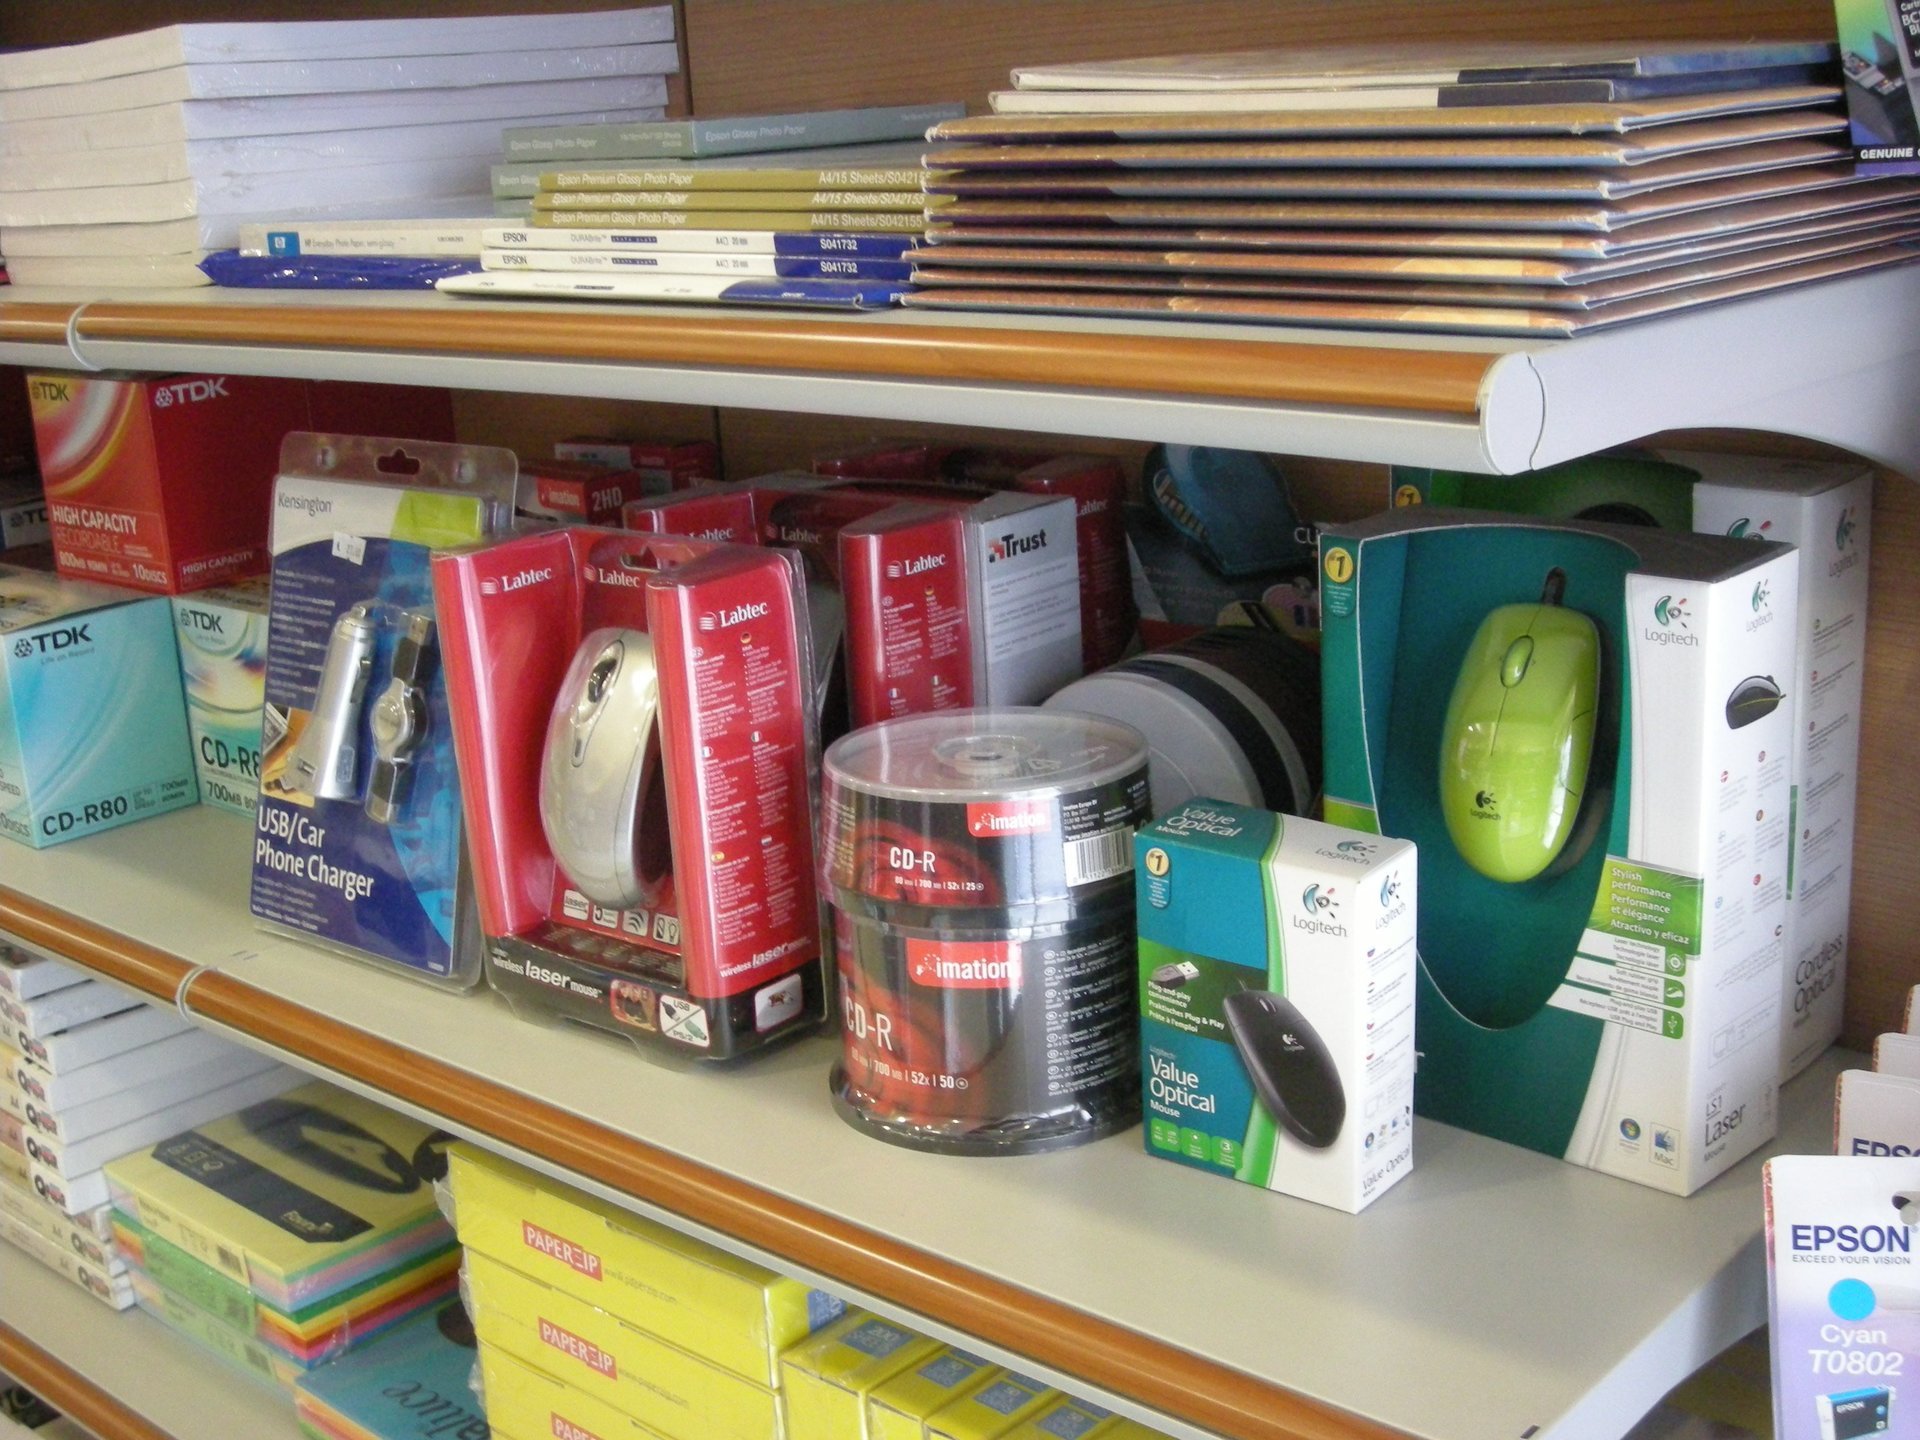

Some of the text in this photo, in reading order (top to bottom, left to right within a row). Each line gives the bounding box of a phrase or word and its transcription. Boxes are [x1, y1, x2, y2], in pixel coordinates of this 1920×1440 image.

[554, 138, 575, 149] Photo
[576, 138, 598, 150] Paper
[705, 125, 807, 143] Epson Glossy Photo Paper
[1860, 147, 1914, 160] GENUINE
[557, 172, 694, 187] Epson Premium Glossy Photo Paper
[819, 171, 847, 184] A4/15
[552, 192, 688, 206] Epson Premium Glossy Photo Paper
[811, 193, 925, 206] A4/15 Sheets/S042155
[552, 212, 688, 226] Epson Premium Glossy Photo Paper
[811, 213, 923, 228] A4/15 Sheets/S042155
[502, 232, 528, 243] EPSON
[819, 238, 858, 251] S041732
[502, 254, 528, 265] EPSON
[820, 261, 858, 274] S041732
[39, 382, 70, 402] TDK
[170, 377, 230, 405] TDK
[278, 492, 333, 518] Kensington
[592, 486, 623, 512] 2HD
[52, 504, 137, 535] HIGH CAPACITY
[781, 525, 823, 545] Labtec
[1002, 528, 1048, 559] Trust
[182, 562, 207, 576] HIGH
[207, 550, 254, 570] CAPACITY
[905, 553, 946, 577] Labtec
[501, 567, 553, 593] Labtec
[598, 568, 641, 589] Labtec
[189, 609, 225, 635] TDK
[719, 602, 769, 629] Labtec
[31, 623, 93, 654] TDK
[1644, 627, 1699, 647] Logitech
[42, 795, 128, 836] CD-R80
[258, 805, 326, 849] USB/Car
[990, 811, 1047, 830] imation
[1166, 815, 1243, 838] Optical
[1181, 807, 1237, 826] Value
[1154, 825, 1191, 838] Mouse
[890, 846, 937, 873] CD-R
[1314, 846, 1371, 866] Logitech
[256, 838, 375, 902] Phone Charger
[1611, 867, 1643, 882] Stylish
[966, 882, 976, 891] 25
[1611, 880, 1673, 901] performance
[1611, 893, 1671, 915] Performance
[1611, 905, 1665, 925] et élégance
[1293, 914, 1348, 938] Logitech
[1610, 918, 1690, 945] Atractivo y eficaz
[751, 942, 788, 969] laser
[525, 960, 572, 989] laser
[936, 957, 1013, 981] imation
[1147, 980, 1192, 1003] Plug-and-play
[672, 1000, 691, 1011] USB
[1148, 999, 1226, 1031] Praktisches Plug & Play
[845, 995, 893, 1052] CD-R
[874, 1059, 891, 1077] 700
[910, 1071, 930, 1086] 52x
[939, 1075, 955, 1089] 50
[1149, 1053, 1200, 1089] Value
[1149, 1077, 1216, 1114] Optical
[1705, 1094, 1724, 1118] LS1
[1149, 1099, 1181, 1119] Mouse
[1703, 1103, 1746, 1148] Laser
[1654, 1151, 1674, 1166] Mac
[1791, 1224, 1911, 1253] EPSON
[1792, 1253, 1911, 1266] EXCEED YOUR VISION
[1820, 1324, 1887, 1348] Cyan
[1808, 1348, 1904, 1377] T0802
[1835, 1401, 1865, 1414] EPSON
